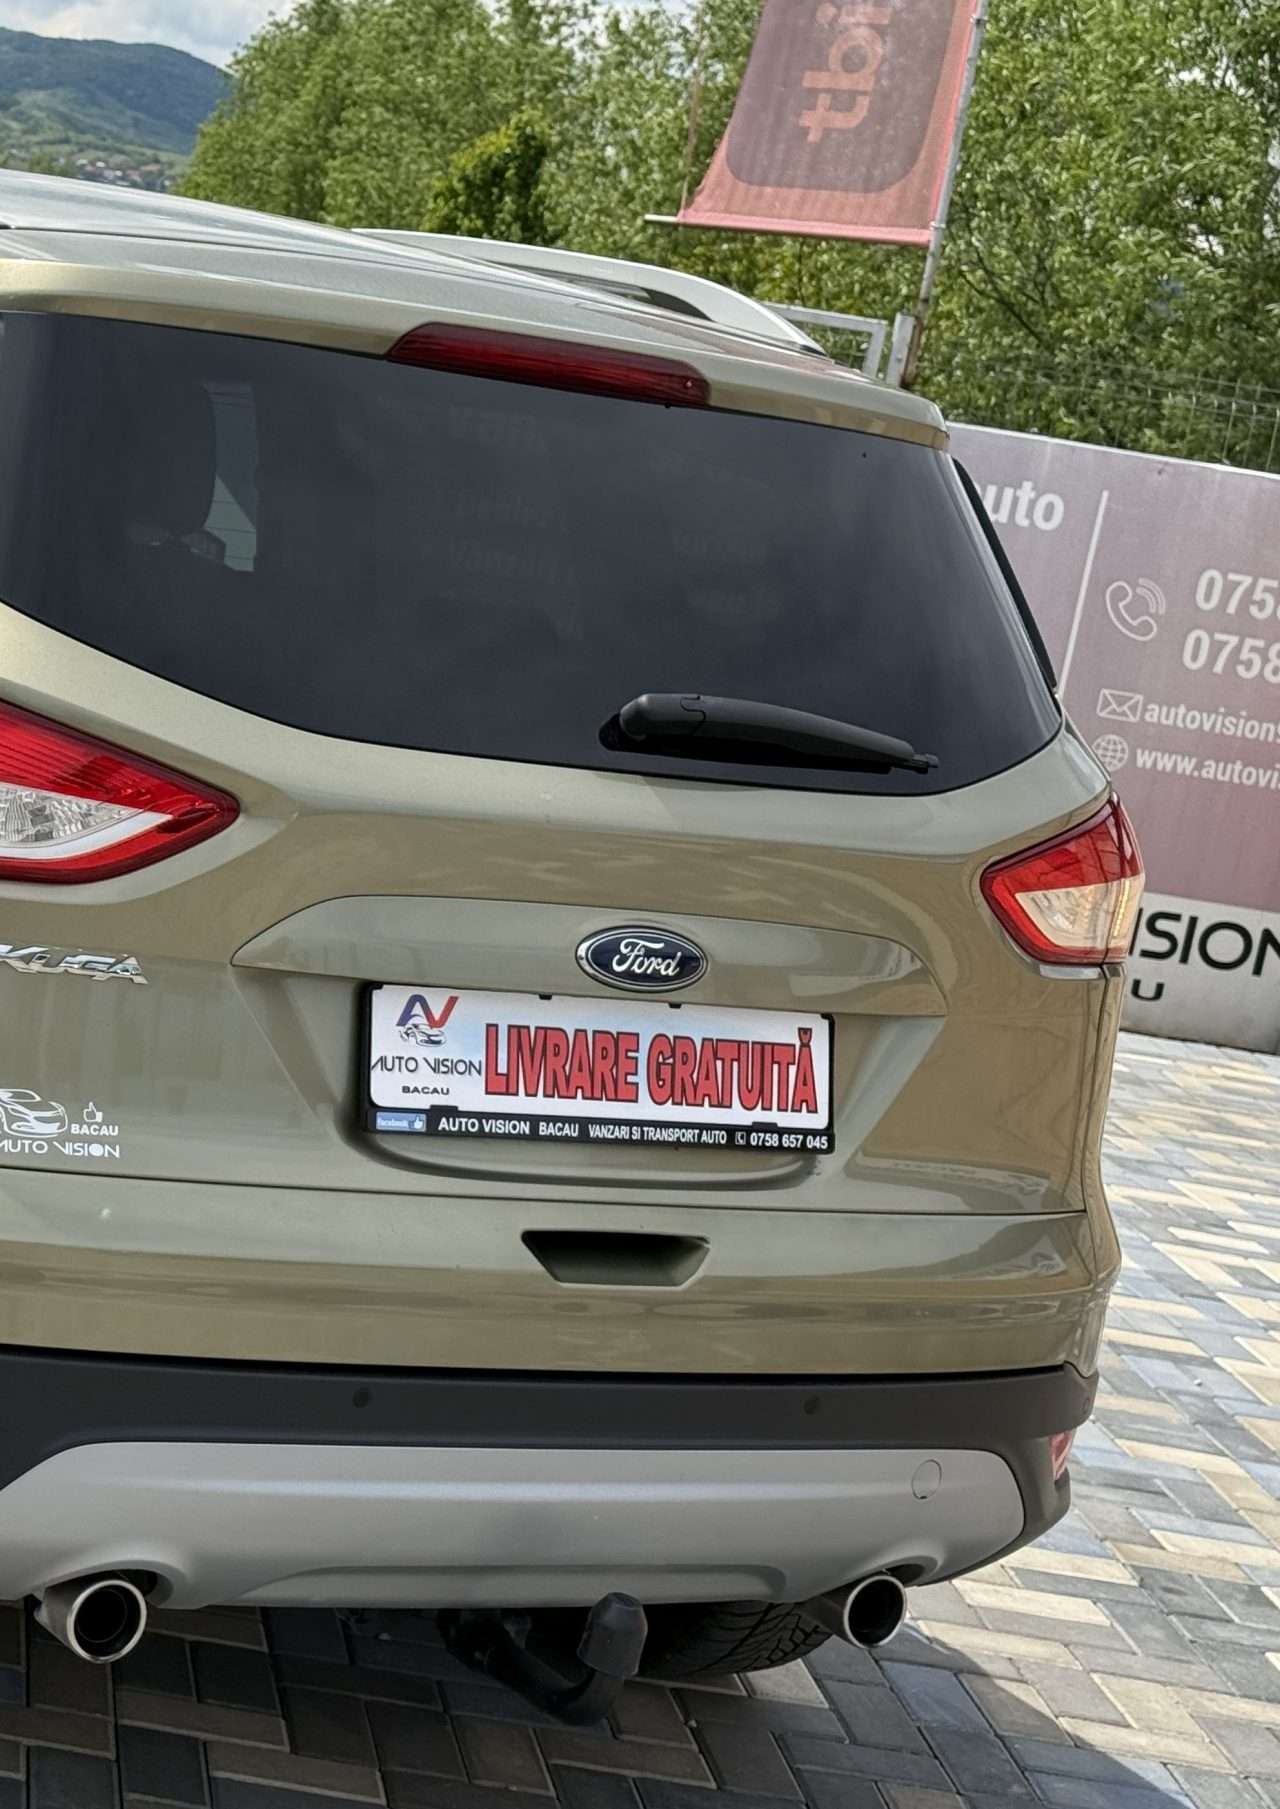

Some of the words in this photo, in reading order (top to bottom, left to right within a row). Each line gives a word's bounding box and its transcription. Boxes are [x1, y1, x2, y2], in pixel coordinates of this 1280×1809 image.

[977, 480, 1065, 531] uto
[1195, 568, 1280, 621] 075
[1144, 703, 1280, 744] autovision
[1136, 748, 1280, 791] www.autovi
[612, 938, 682, 976] Ford
[371, 1055, 418, 1073] AUTO
[423, 1057, 482, 1076] VISION
[485, 1023, 639, 1103] LIVRARE
[646, 1027, 818, 1114] GRATUITĂ
[402, 1085, 450, 1095] BACAU
[71, 1123, 119, 1137] BACAU
[438, 1117, 479, 1132] AUTO
[482, 1119, 530, 1135] VISION
[539, 1121, 579, 1137] BACAU
[588, 1124, 630, 1140] VANZARI
[631, 1126, 641, 1140] SI
[643, 1127, 699, 1143] TRANSPORT
[701, 1130, 727, 1145] AUTO
[750, 1132, 779, 1147] 0758
[782, 1133, 802, 1147] 657
[806, 1134, 828, 1149] 045
[53, 1141, 120, 1159] VISION
